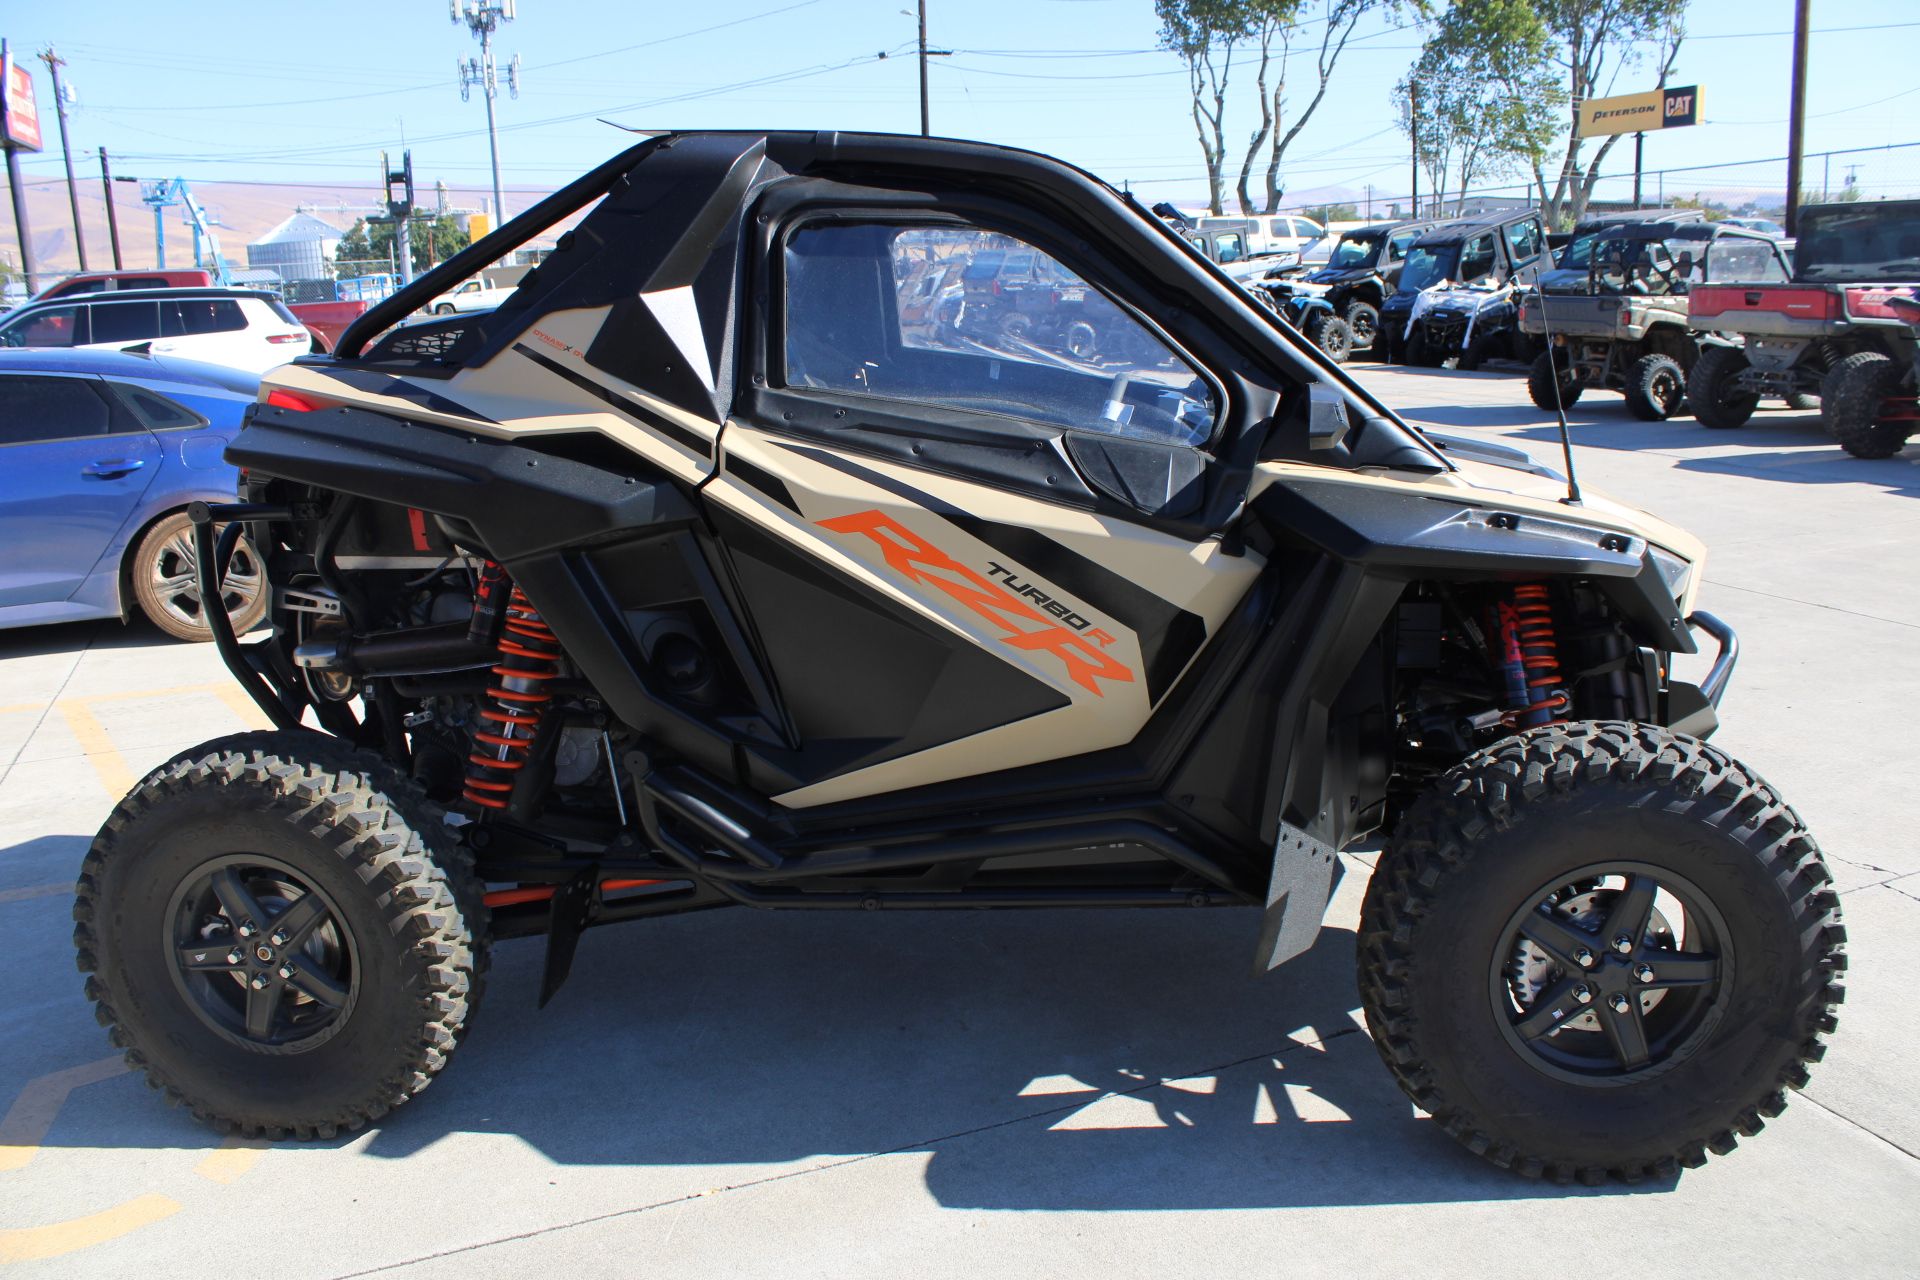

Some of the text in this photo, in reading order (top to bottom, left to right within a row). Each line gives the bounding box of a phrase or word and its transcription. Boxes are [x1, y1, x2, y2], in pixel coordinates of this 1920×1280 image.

[1592, 95, 1692, 123] PETERSON CAT
[532, 329, 573, 352] DYNAMIX
[814, 508, 1135, 698] RZR
[987, 561, 1116, 649] TURBO R
